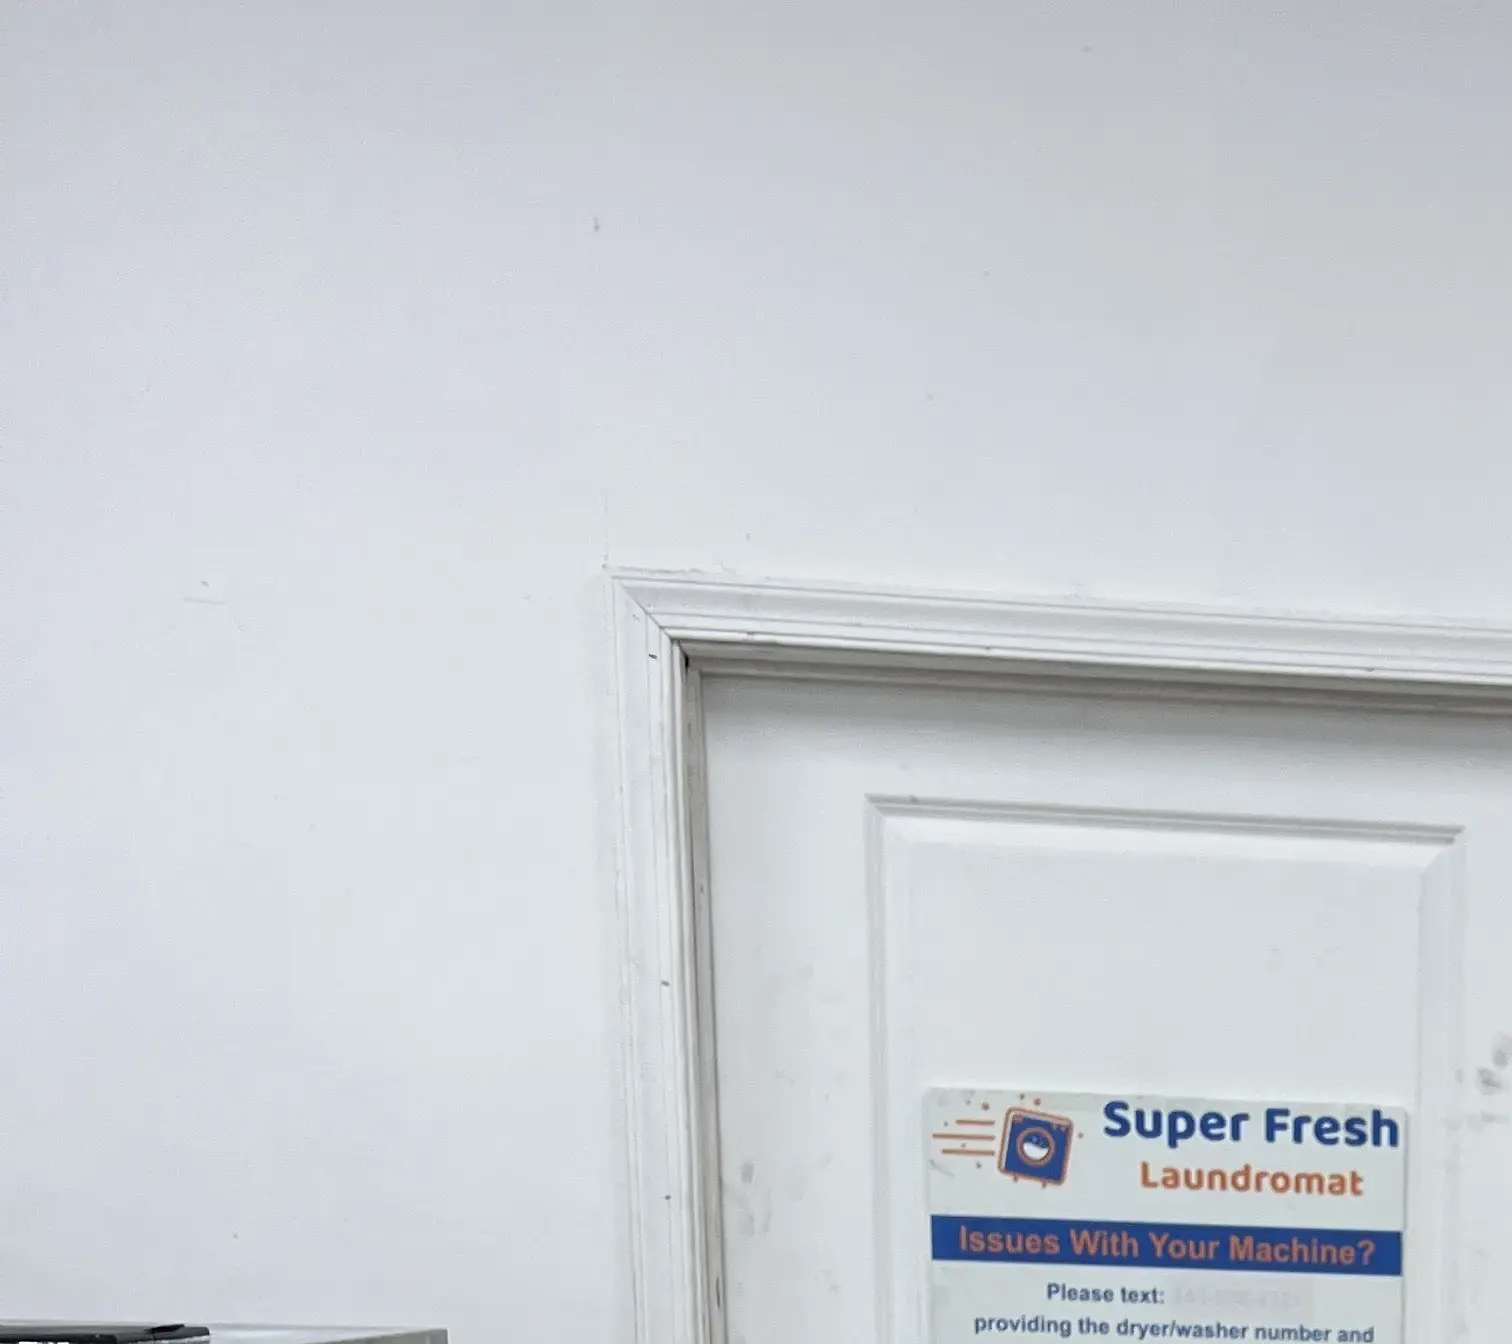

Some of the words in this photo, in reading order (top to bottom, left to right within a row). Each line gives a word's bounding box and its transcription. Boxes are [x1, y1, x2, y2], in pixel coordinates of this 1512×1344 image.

[1103, 1100, 1250, 1149] Super
[1264, 1107, 1399, 1148] Fresh
[1140, 1161, 1364, 1196] Laundromat
[959, 1225, 1060, 1255] Issues
[1069, 1228, 1139, 1257] With
[1148, 1232, 1220, 1260] Your
[1228, 1235, 1376, 1265] Machine?
[1046, 1282, 1114, 1303] Please
[1120, 1286, 1165, 1304] text:
[974, 1315, 1072, 1338] providing
[1078, 1317, 1110, 1334] the
[1116, 1318, 1249, 1340] dryer/washer
[1254, 1324, 1332, 1342] number
[1336, 1326, 1375, 1343] and
